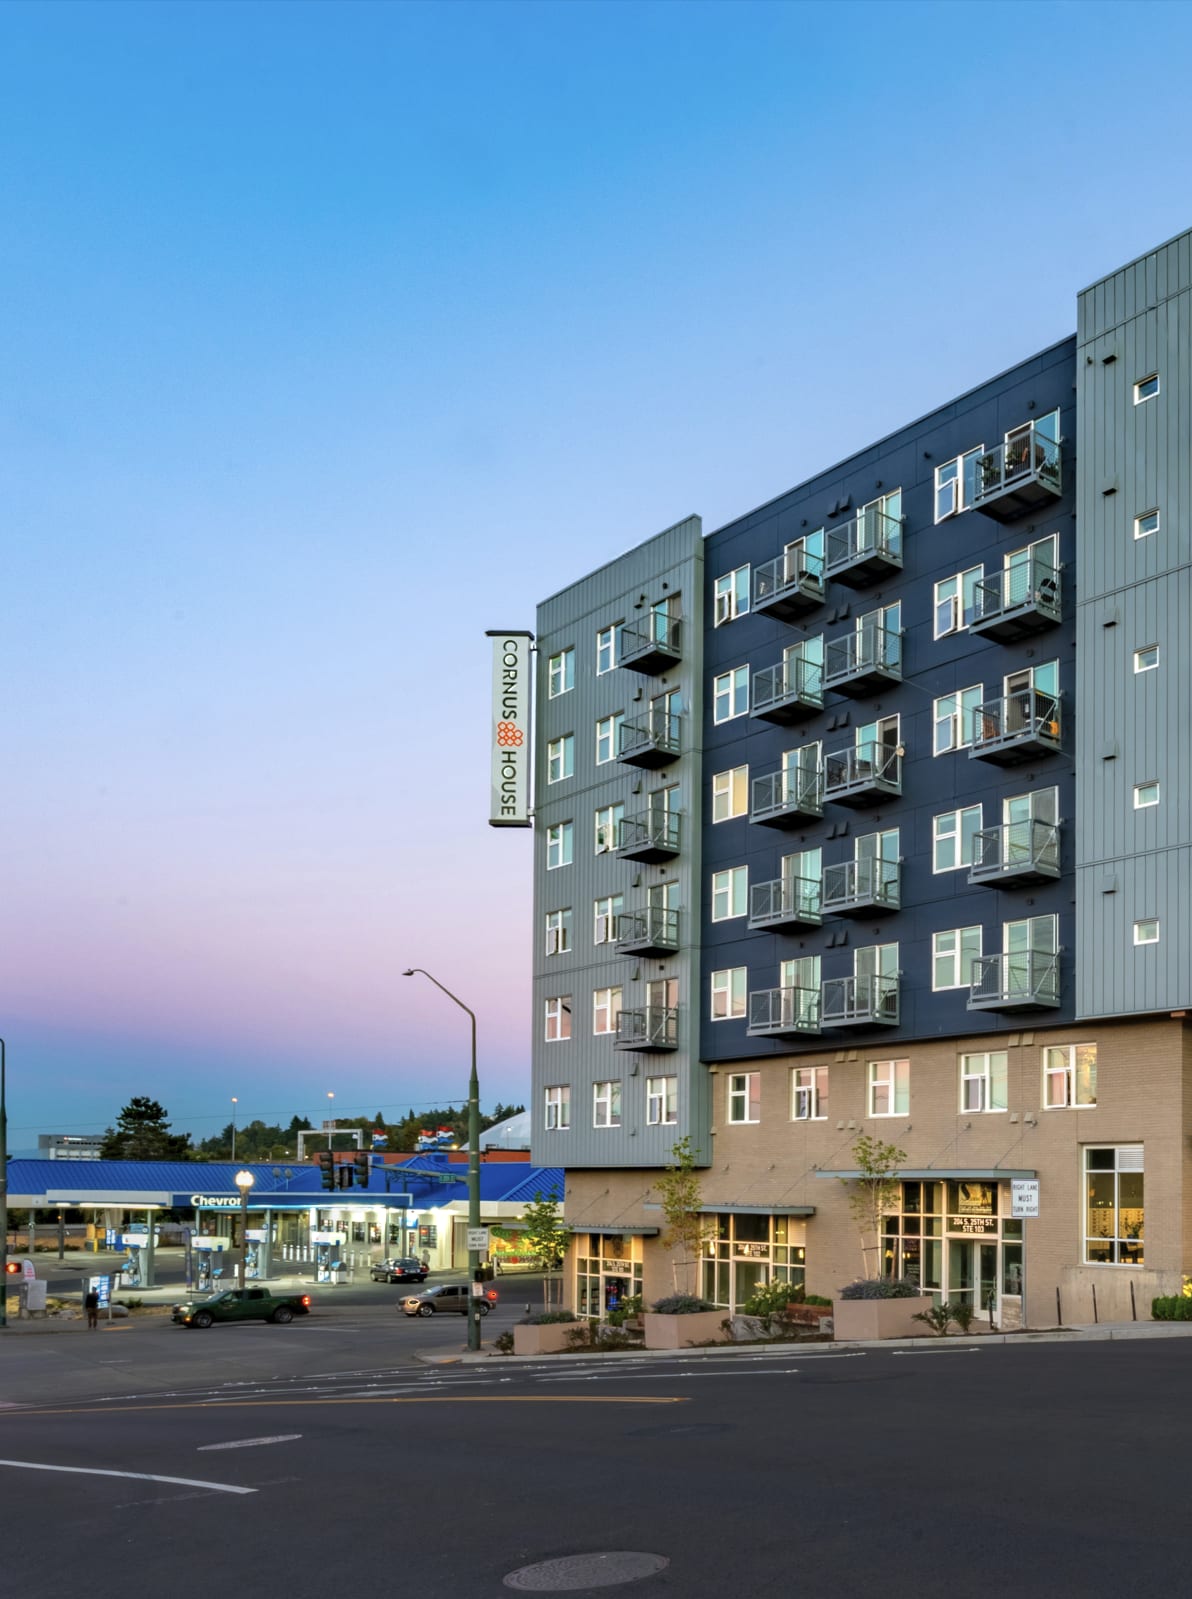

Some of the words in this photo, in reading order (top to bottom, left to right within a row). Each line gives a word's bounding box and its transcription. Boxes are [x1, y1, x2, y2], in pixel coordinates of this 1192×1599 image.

[503, 640, 517, 719] CORNUS
[501, 751, 516, 815] HOUSE
[1018, 1194, 1032, 1202] MUST
